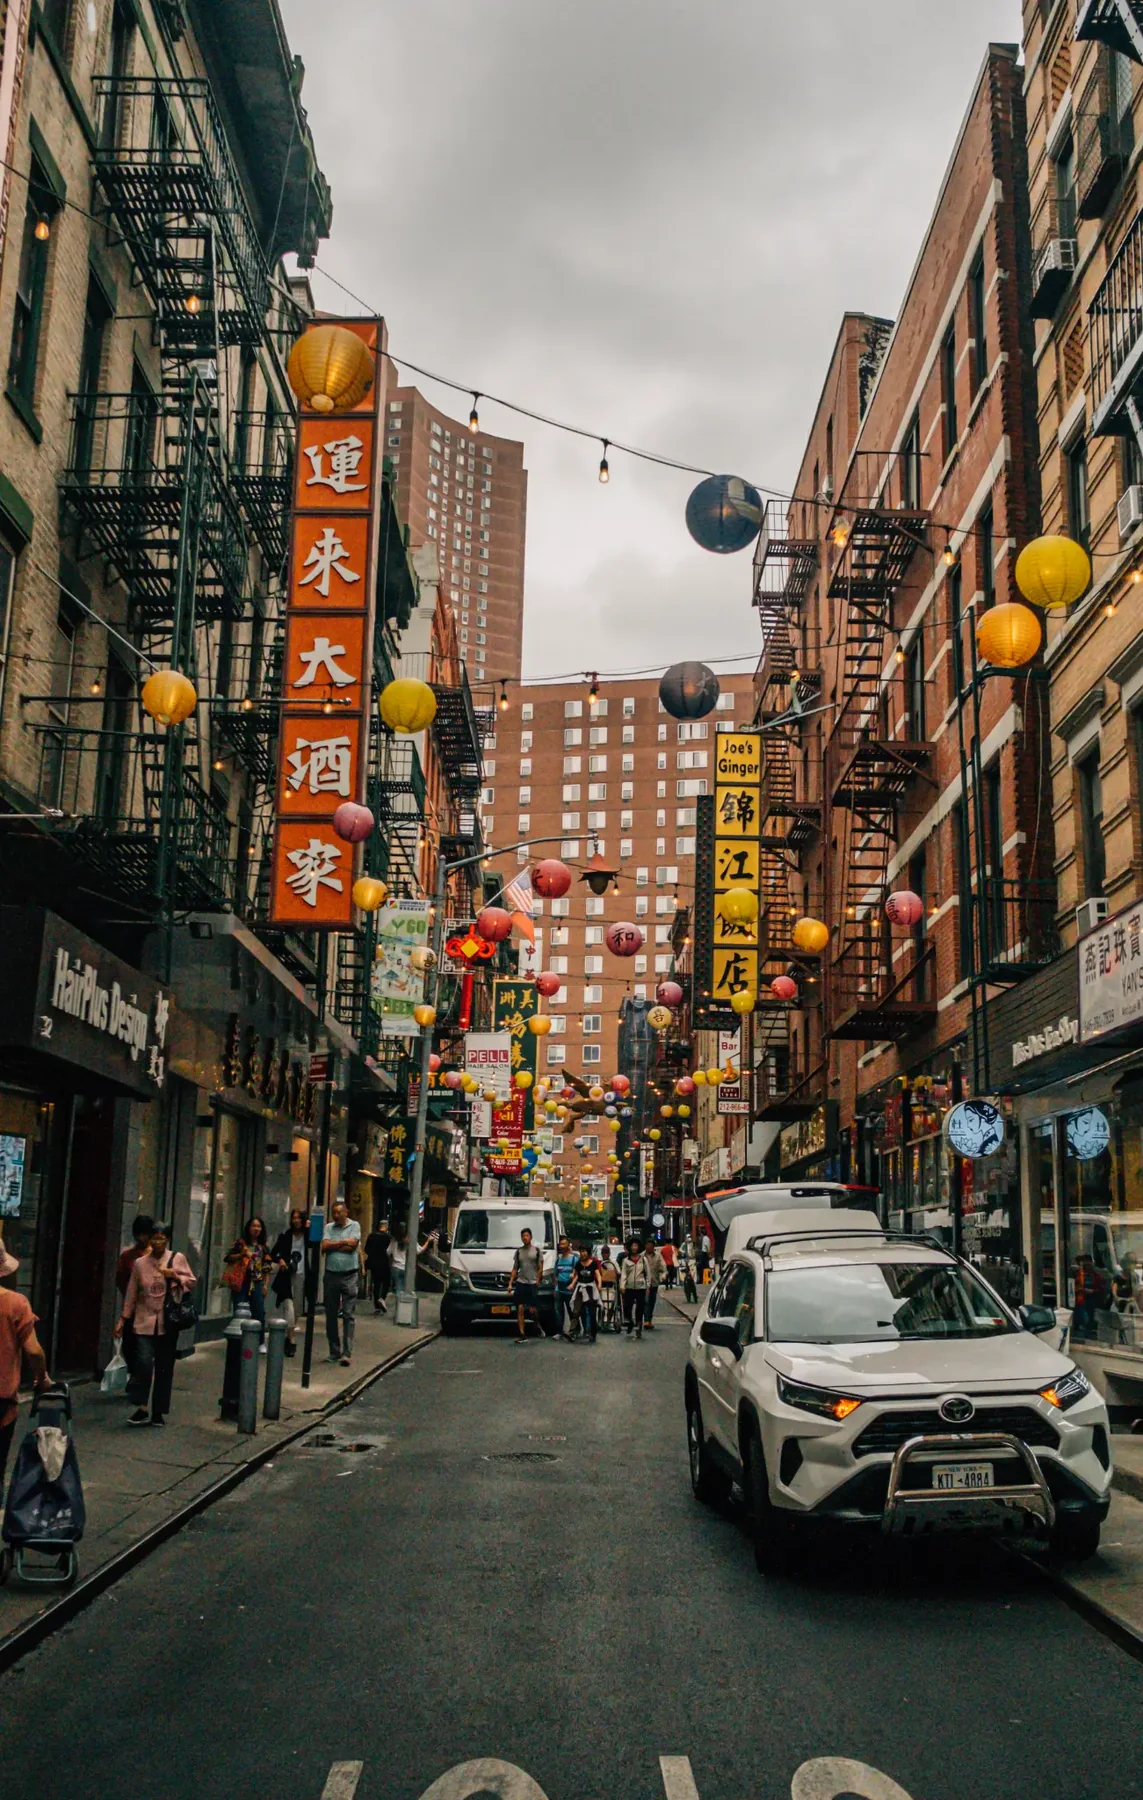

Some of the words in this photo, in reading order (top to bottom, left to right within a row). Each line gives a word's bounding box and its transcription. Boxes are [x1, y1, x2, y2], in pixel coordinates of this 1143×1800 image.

[285, 435, 368, 907] 運來大酒家
[724, 740, 753, 754] Joe's
[718, 758, 759, 777] Ginger
[612, 927, 635, 948] 和
[1085, 914, 1141, 985] 燕記珠寶
[52, 947, 109, 1031] HairPlus
[109, 981, 148, 1061] Design
[721, 1041, 738, 1051] Bar
[468, 1051, 508, 1062] PELL
